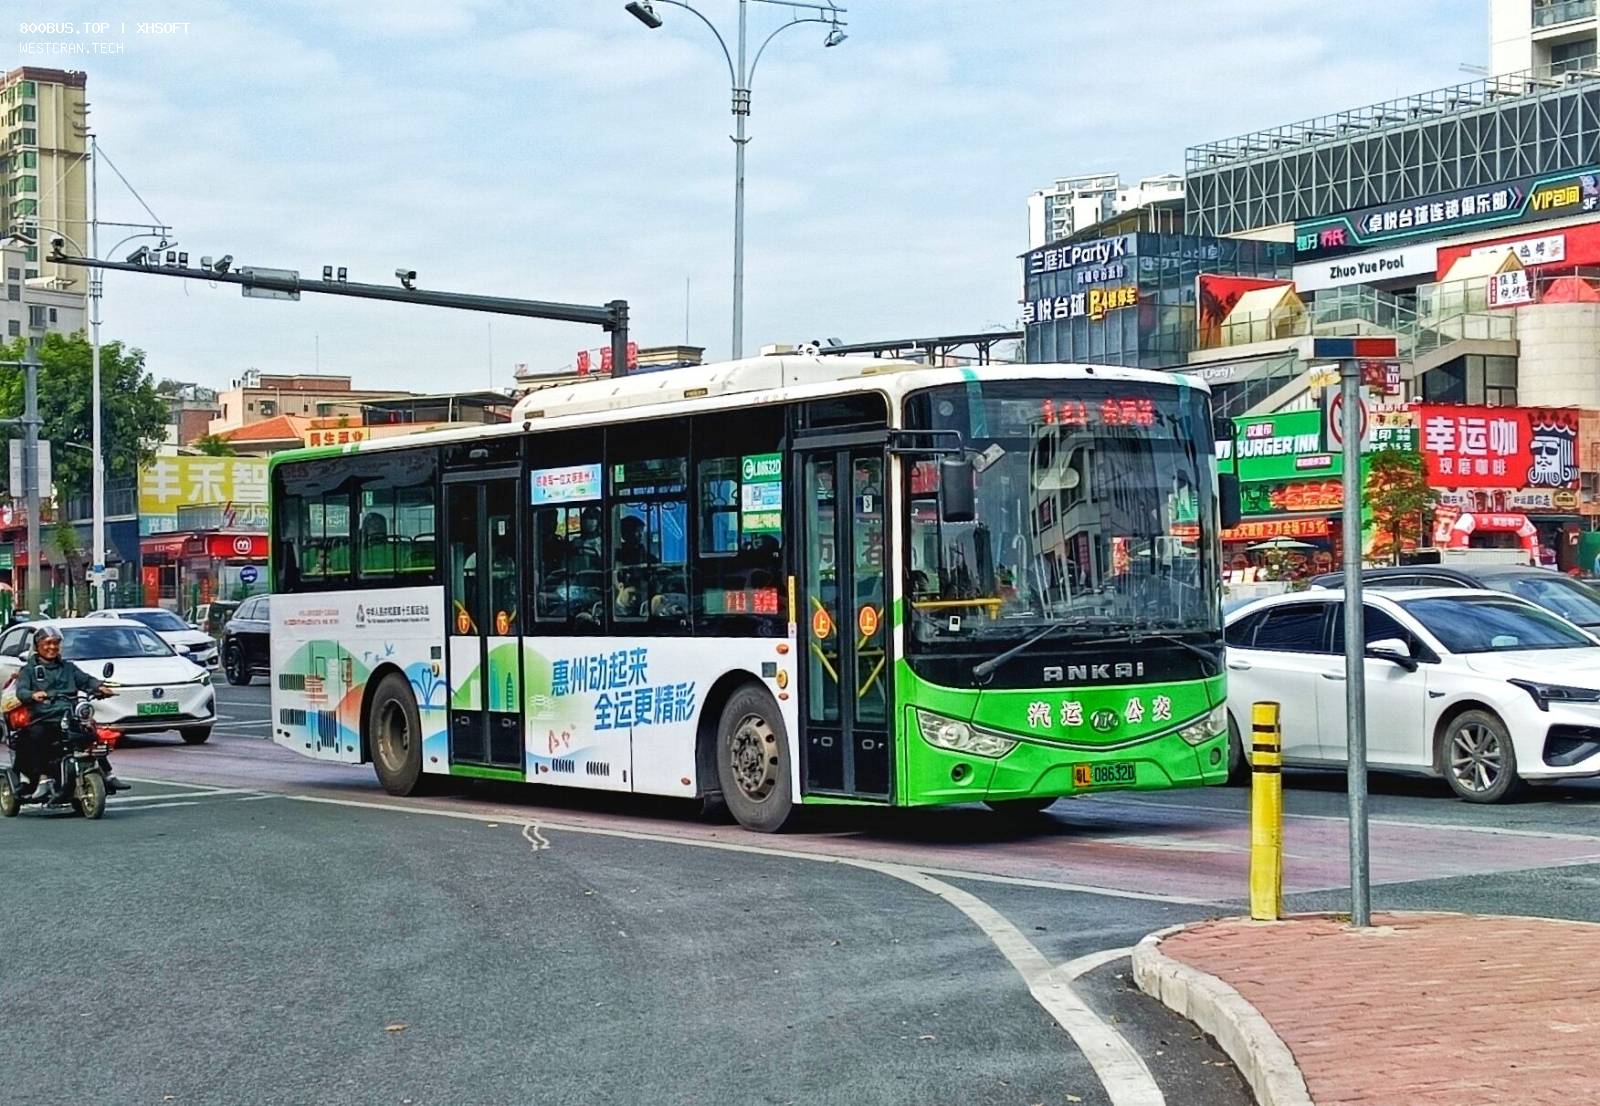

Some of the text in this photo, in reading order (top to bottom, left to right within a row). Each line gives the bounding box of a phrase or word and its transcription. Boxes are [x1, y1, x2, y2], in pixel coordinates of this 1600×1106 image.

[1369, 190, 1508, 233] 卓悦台球连锁俱乐部
[1330, 255, 1404, 279] Zhuo Yue Pool
[1237, 437, 1294, 458] BURGER
[1294, 433, 1320, 453] INN
[1426, 416, 1518, 455] 幸运咖
[1439, 457, 1506, 476] 现磨咖啡
[552, 648, 648, 696] 惠州动起来
[1043, 662, 1144, 681] ANKAI
[594, 682, 696, 730] 全运更精彩
[1124, 697, 1172, 723] 公交
